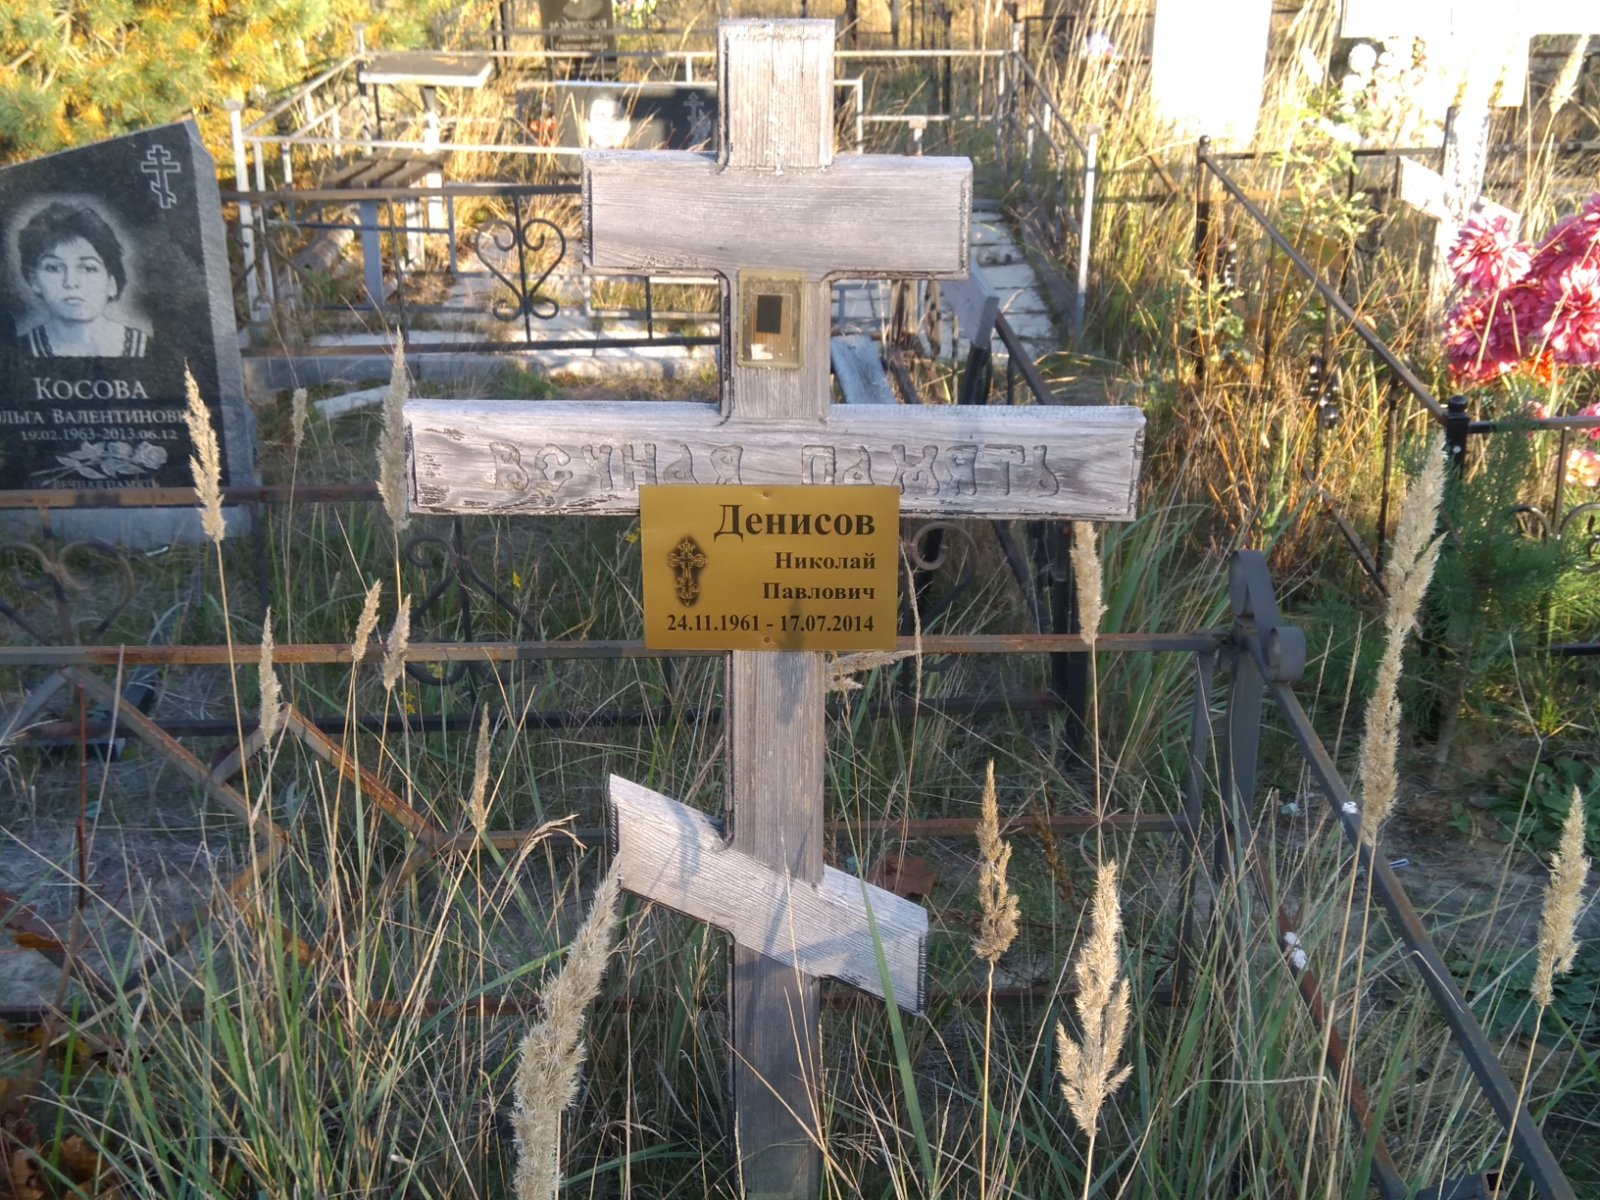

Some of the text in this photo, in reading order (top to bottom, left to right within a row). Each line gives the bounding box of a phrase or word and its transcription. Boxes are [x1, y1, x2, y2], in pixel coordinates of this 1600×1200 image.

[33, 377, 149, 400] КОСОВА
[0, 410, 45, 424] ЛЬГА
[489, 442, 1059, 497] ВЕЧНАЯ ПАМЯТЬ
[714, 504, 875, 542] Денисов
[775, 552, 876, 569] Николай
[763, 582, 875, 600] Павлович
[667, 614, 759, 632] 24.11.1961
[780, 614, 874, 632] 17.07.2014
